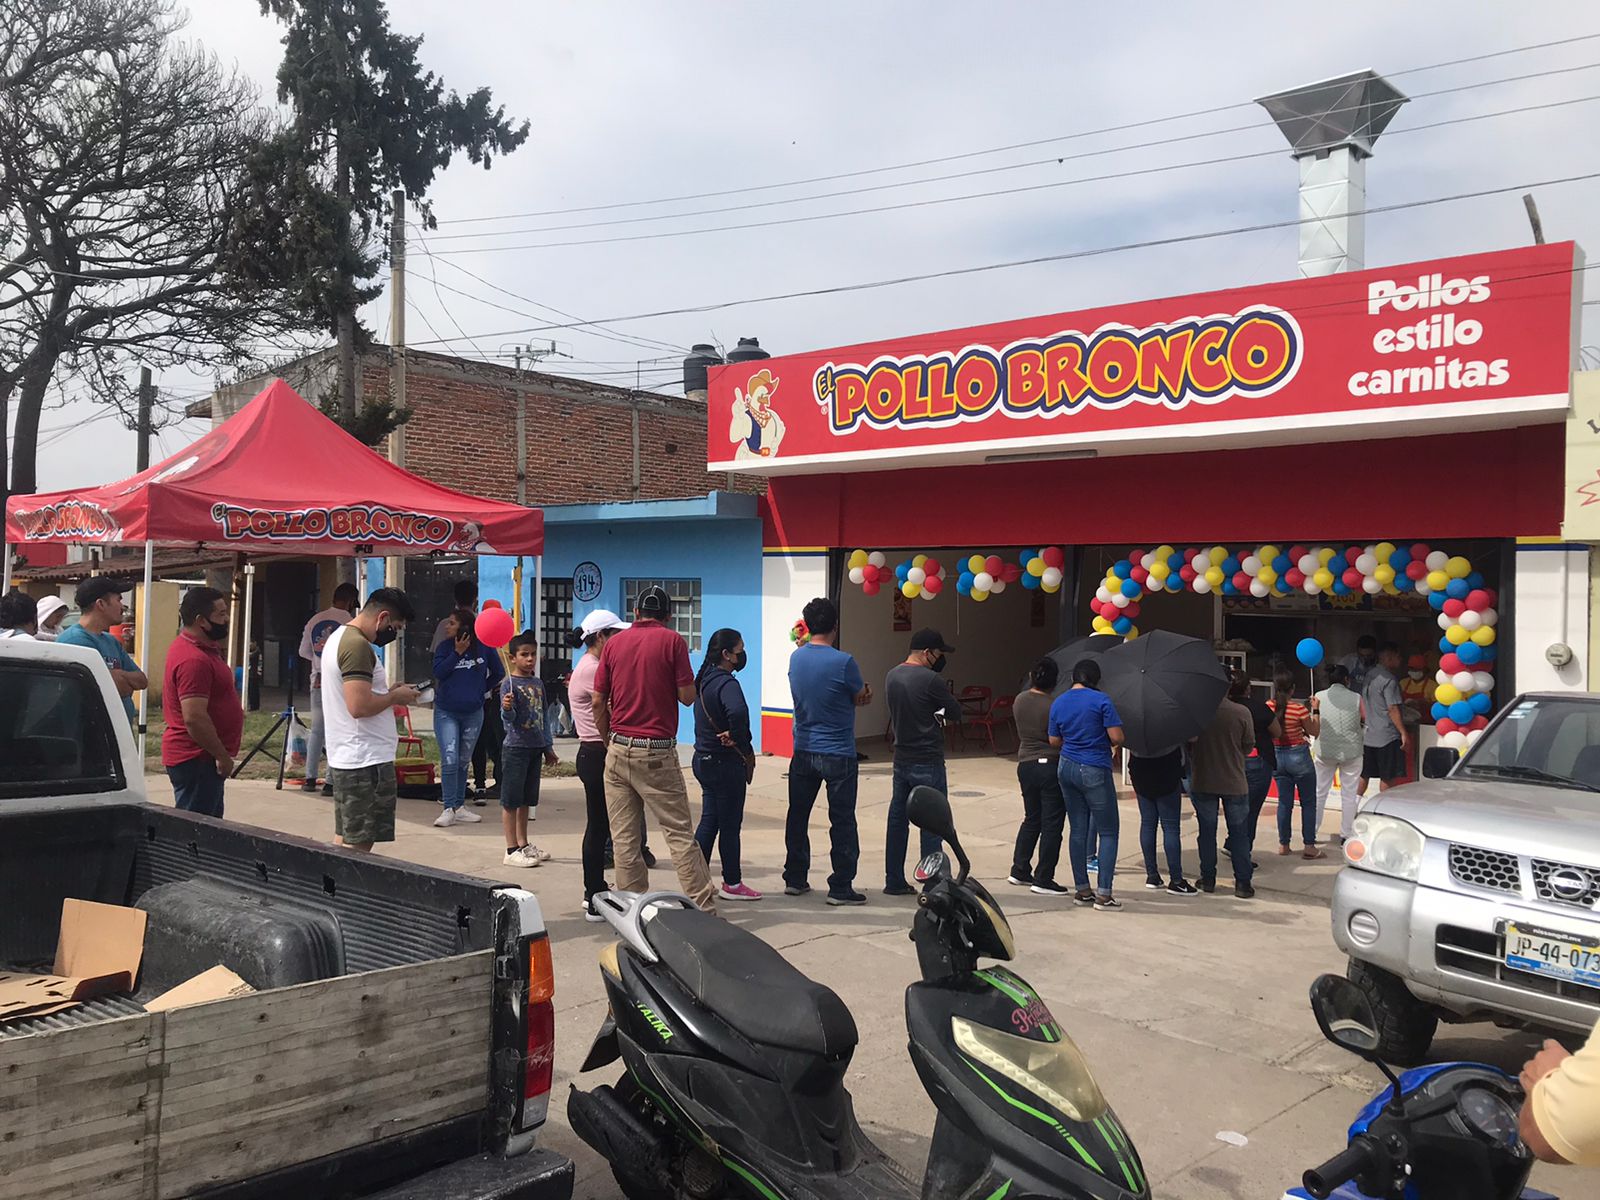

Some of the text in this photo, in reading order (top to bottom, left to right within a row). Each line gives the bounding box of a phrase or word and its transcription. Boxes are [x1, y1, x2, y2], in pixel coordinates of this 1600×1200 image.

[1368, 273, 1491, 315] Pollos
[1373, 313, 1483, 354] estilo
[816, 309, 1298, 431] El POLLO BRONCO
[1348, 356, 1510, 397] carnitas
[225, 508, 328, 538] POLLO
[329, 505, 453, 543] BRONCO
[578, 574, 596, 592] 194
[1511, 936, 1600, 972] JP-44-073
[636, 1000, 674, 1040] TALIKA
